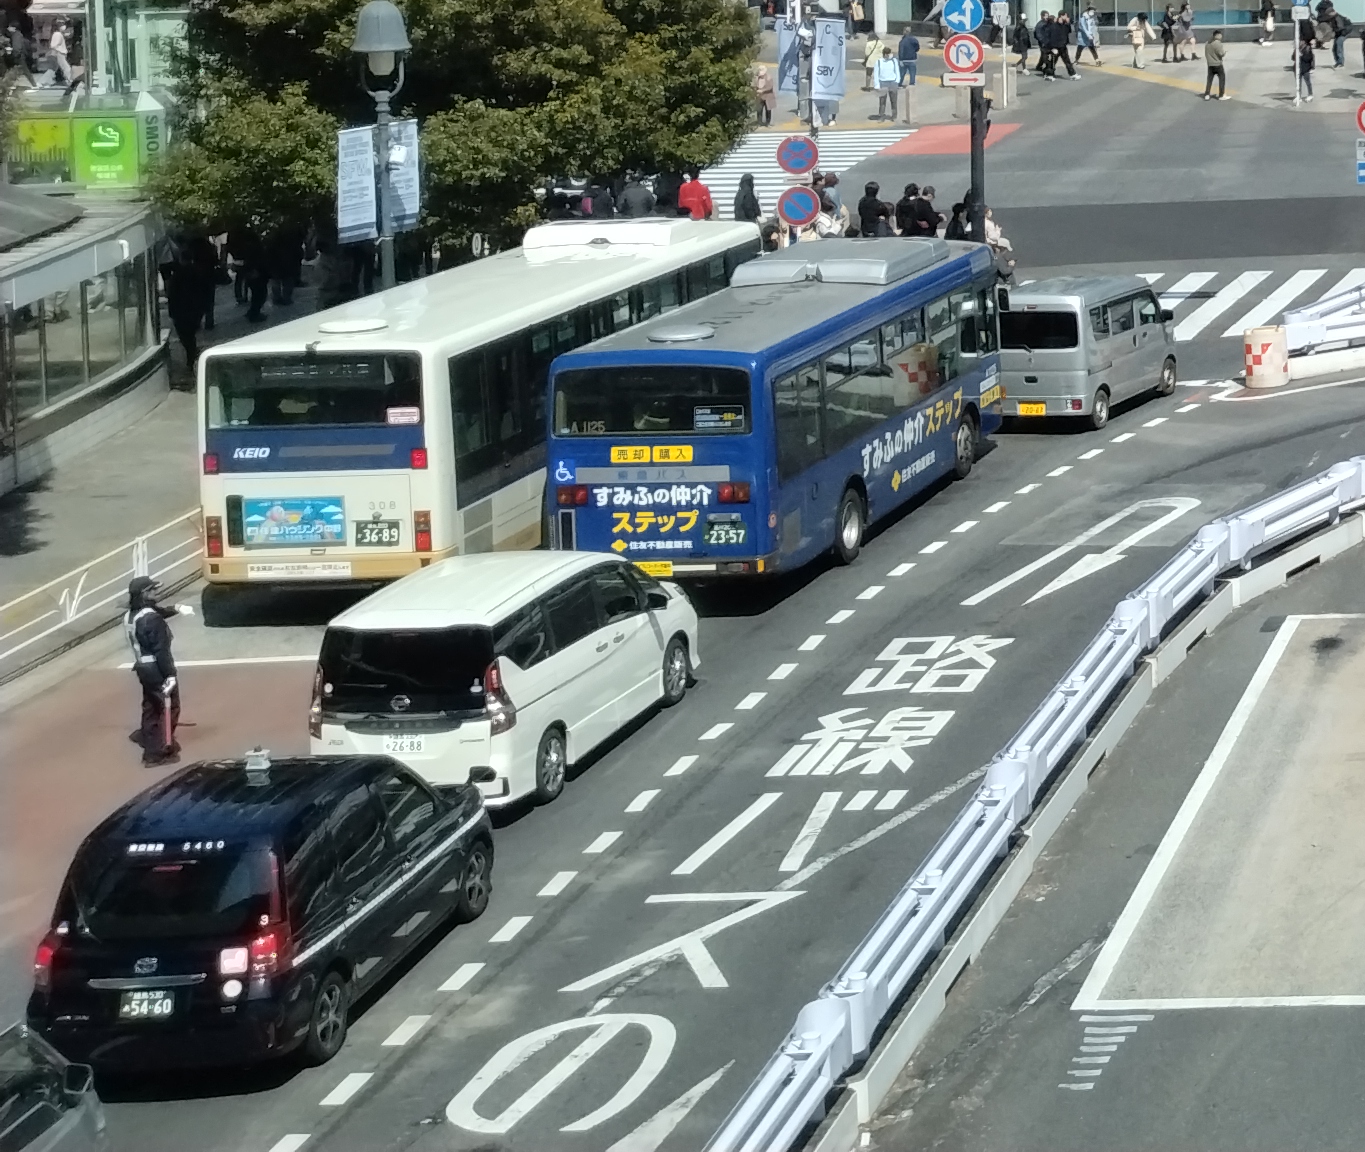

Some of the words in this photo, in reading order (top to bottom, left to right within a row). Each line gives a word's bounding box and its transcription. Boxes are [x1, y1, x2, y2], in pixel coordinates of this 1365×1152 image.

[233, 447, 271, 459] KEIO
[617, 449, 644, 460] 売却
[659, 449, 686, 460] 購入
[593, 484, 712, 507] すみふの仲介
[368, 501, 396, 510] 308
[612, 509, 699, 533] ステップ
[362, 528, 399, 543] 36-89
[709, 530, 745, 544] 23-57
[391, 741, 422, 751] 26-88
[131, 998, 172, 1016] 54-60
